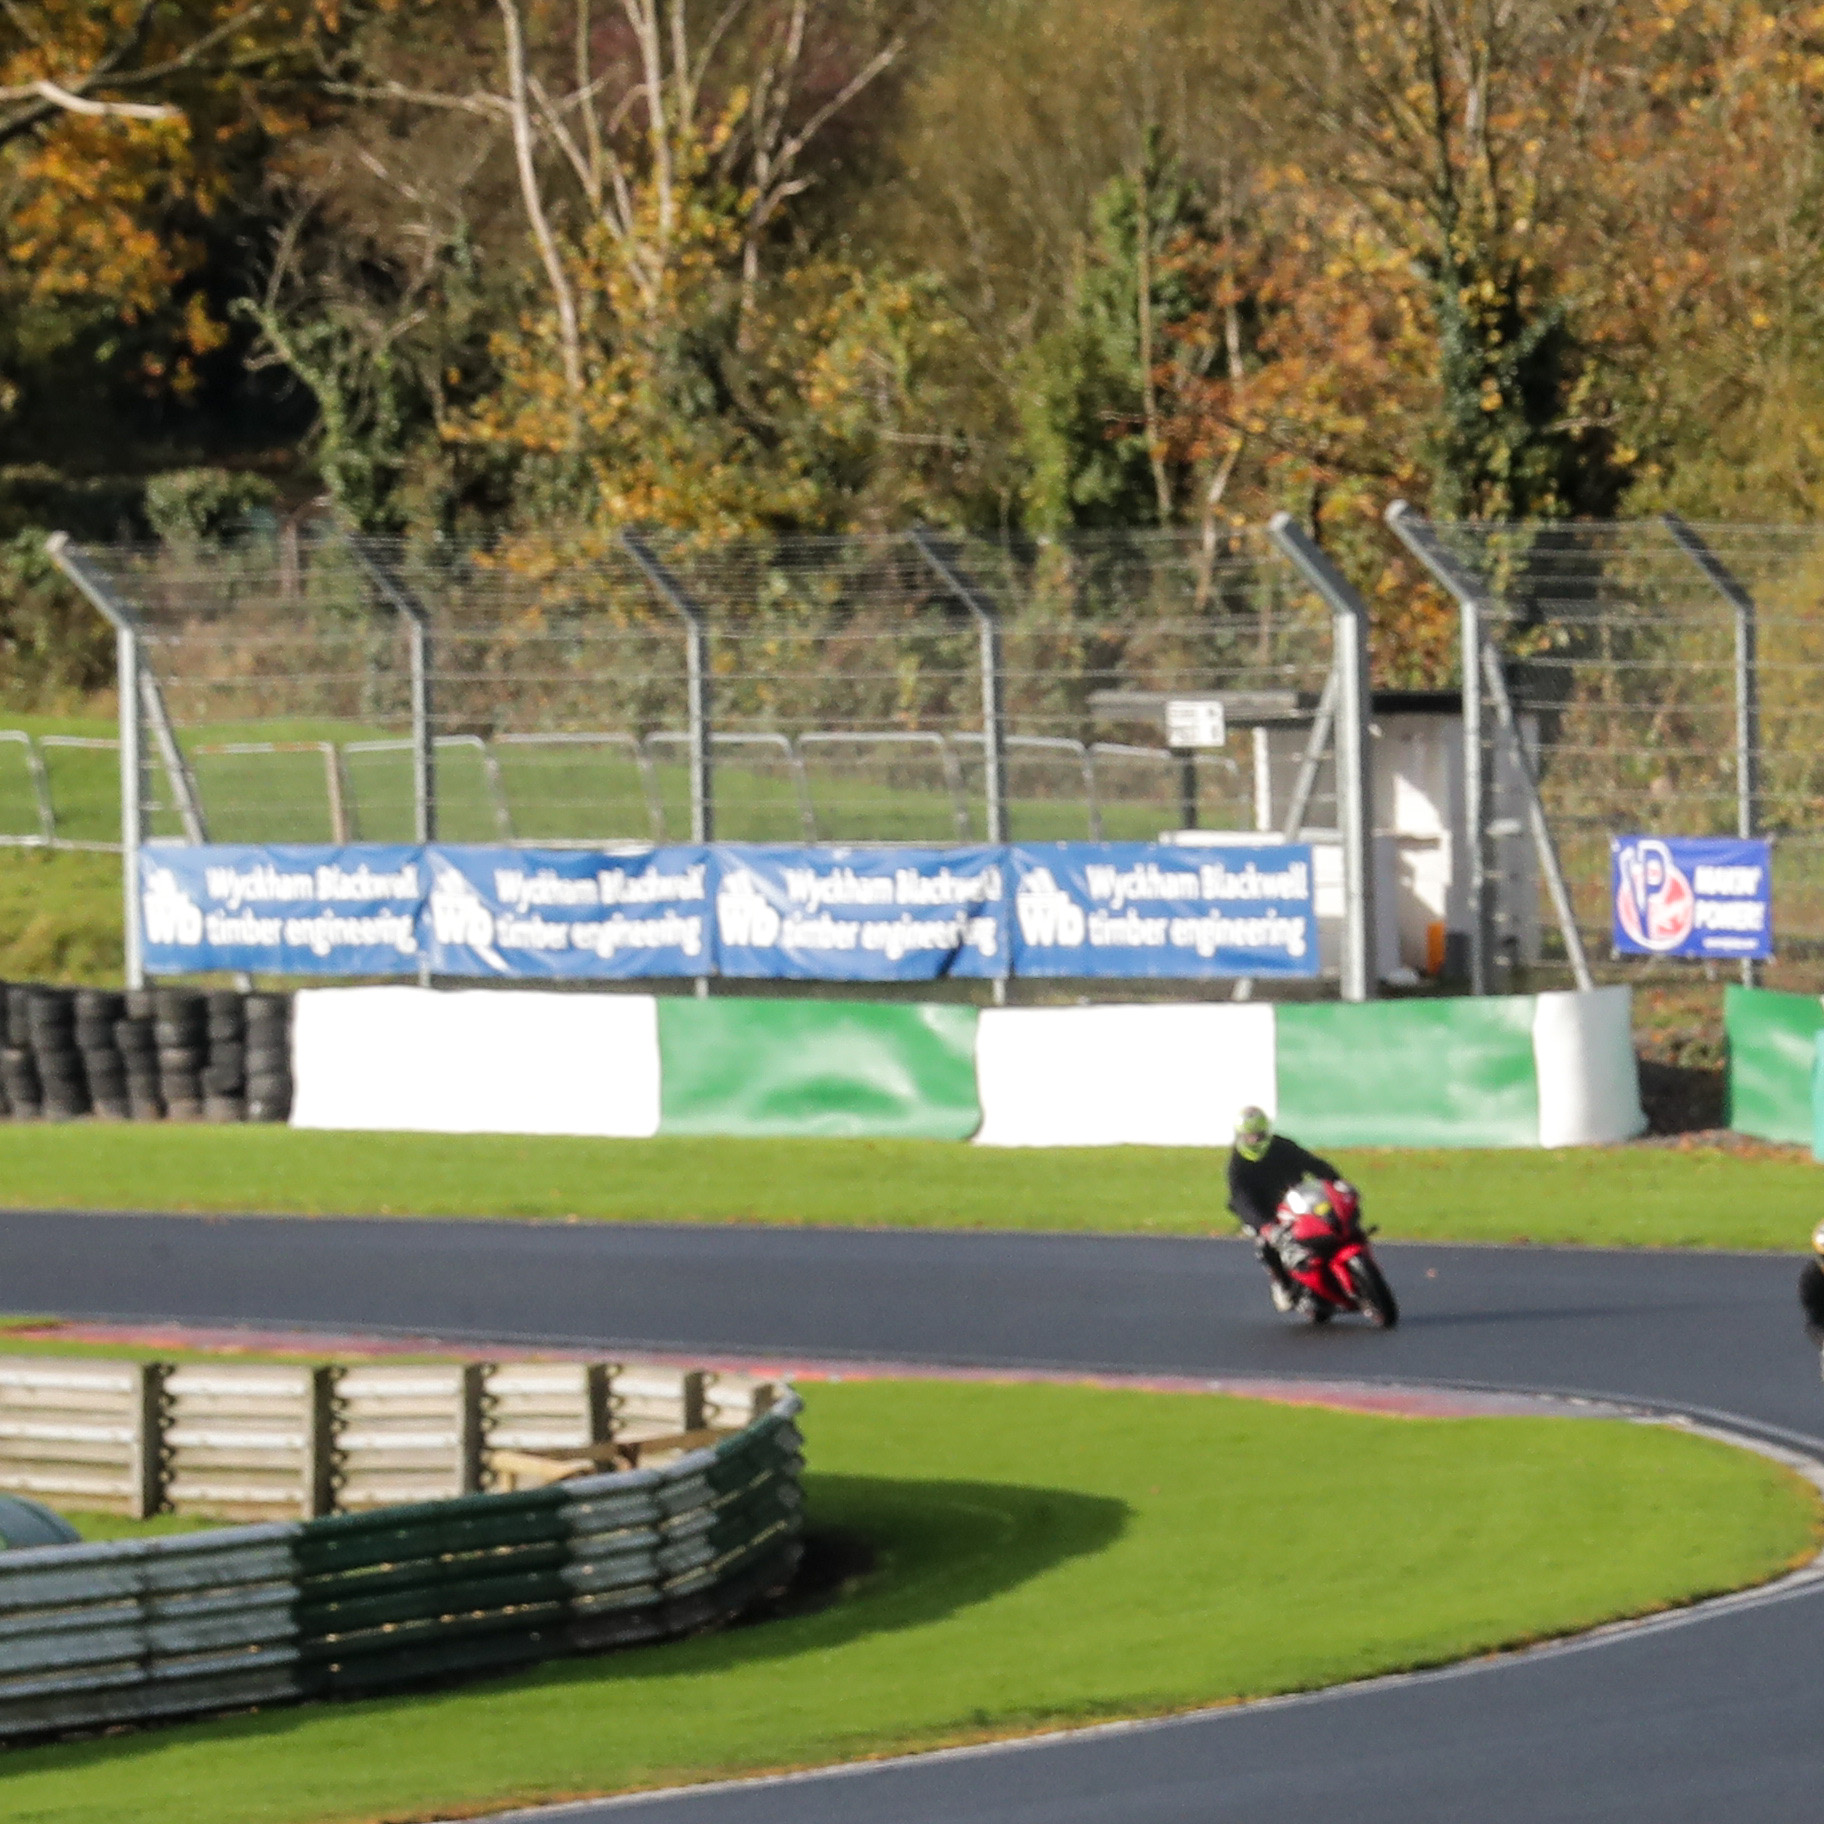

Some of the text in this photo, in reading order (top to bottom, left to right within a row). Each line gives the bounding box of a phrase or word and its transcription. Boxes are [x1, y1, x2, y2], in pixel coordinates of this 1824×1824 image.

[205, 865, 314, 910] Wyckham
[494, 868, 598, 913] Wyckham
[782, 867, 894, 913] Wyckham
[1085, 863, 1200, 910] Wyckham
[205, 907, 418, 956] timber engineering
[495, 911, 703, 958] timber engineering
[781, 910, 997, 960] timber engineering
[1088, 907, 1306, 957] timber engineering
